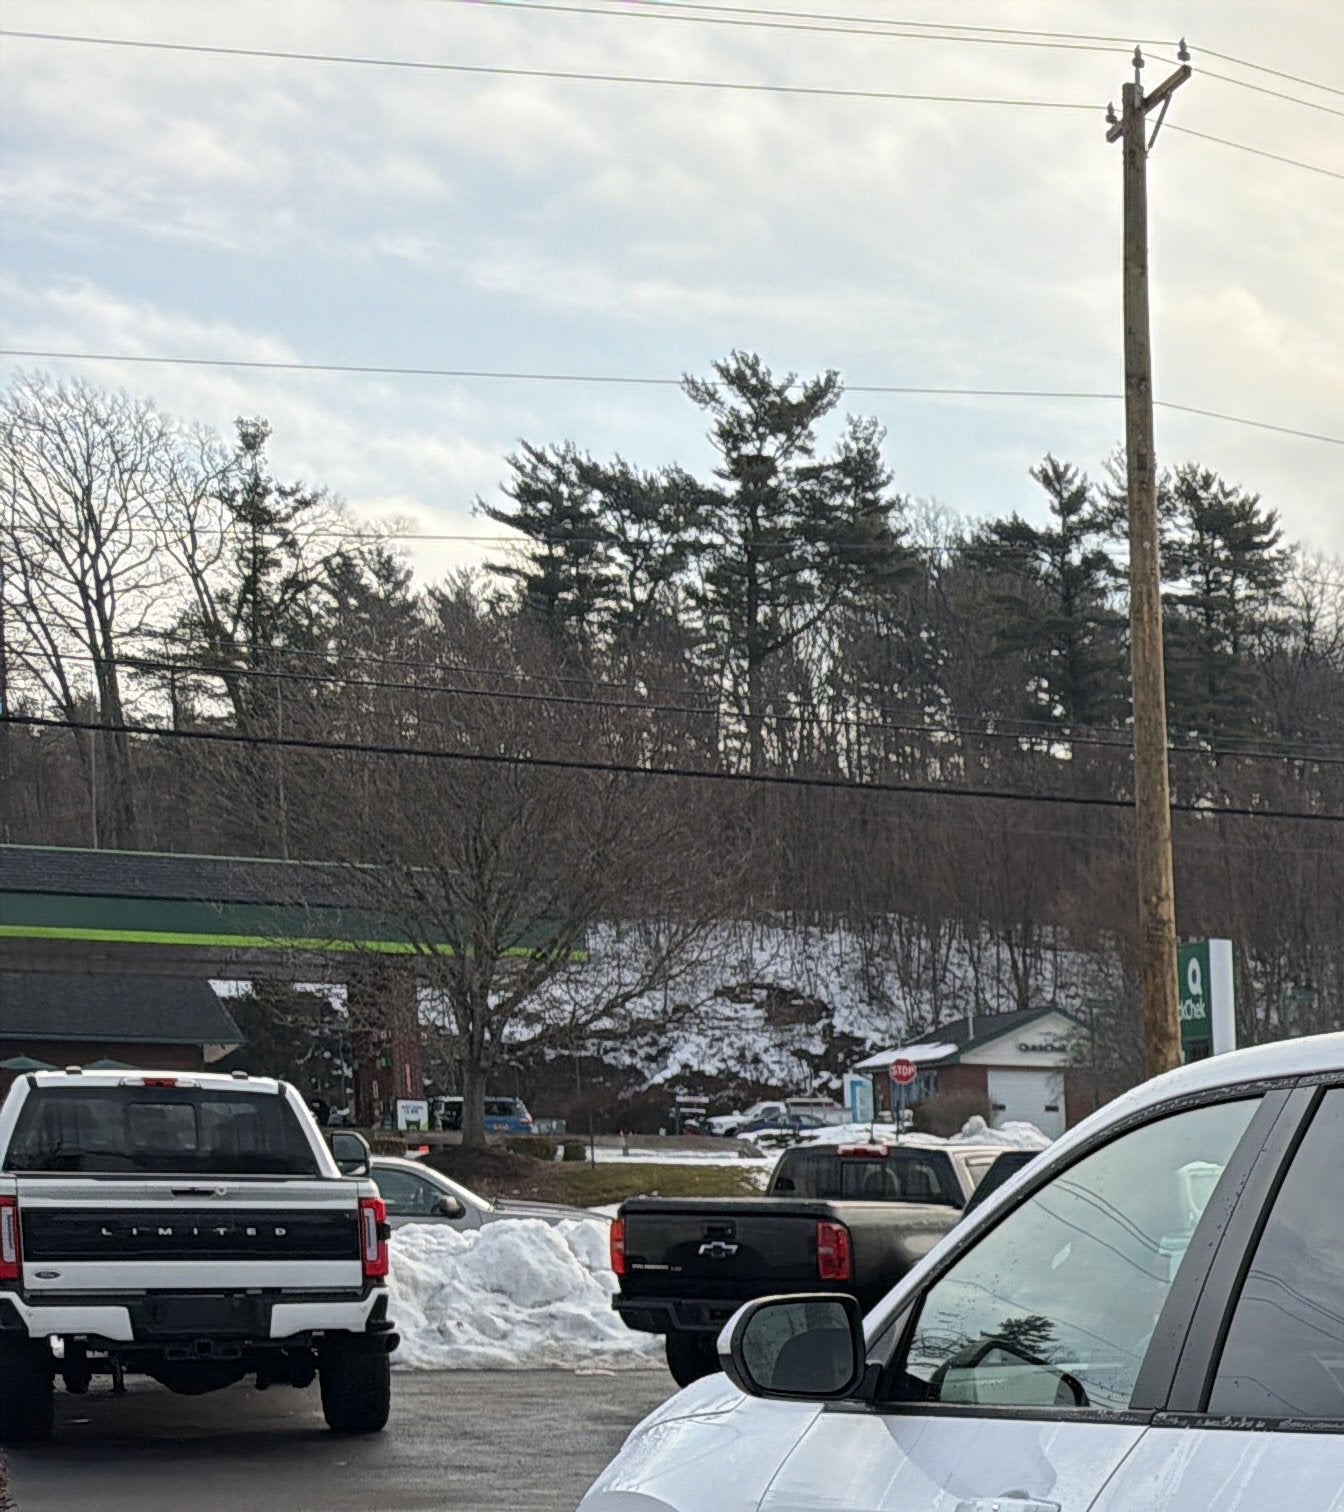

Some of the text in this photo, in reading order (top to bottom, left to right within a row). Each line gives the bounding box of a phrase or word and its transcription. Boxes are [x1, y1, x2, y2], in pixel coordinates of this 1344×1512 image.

[1188, 957, 1202, 995] Q
[891, 1066, 915, 1077] STOP
[101, 1227, 287, 1236] LIMITED
